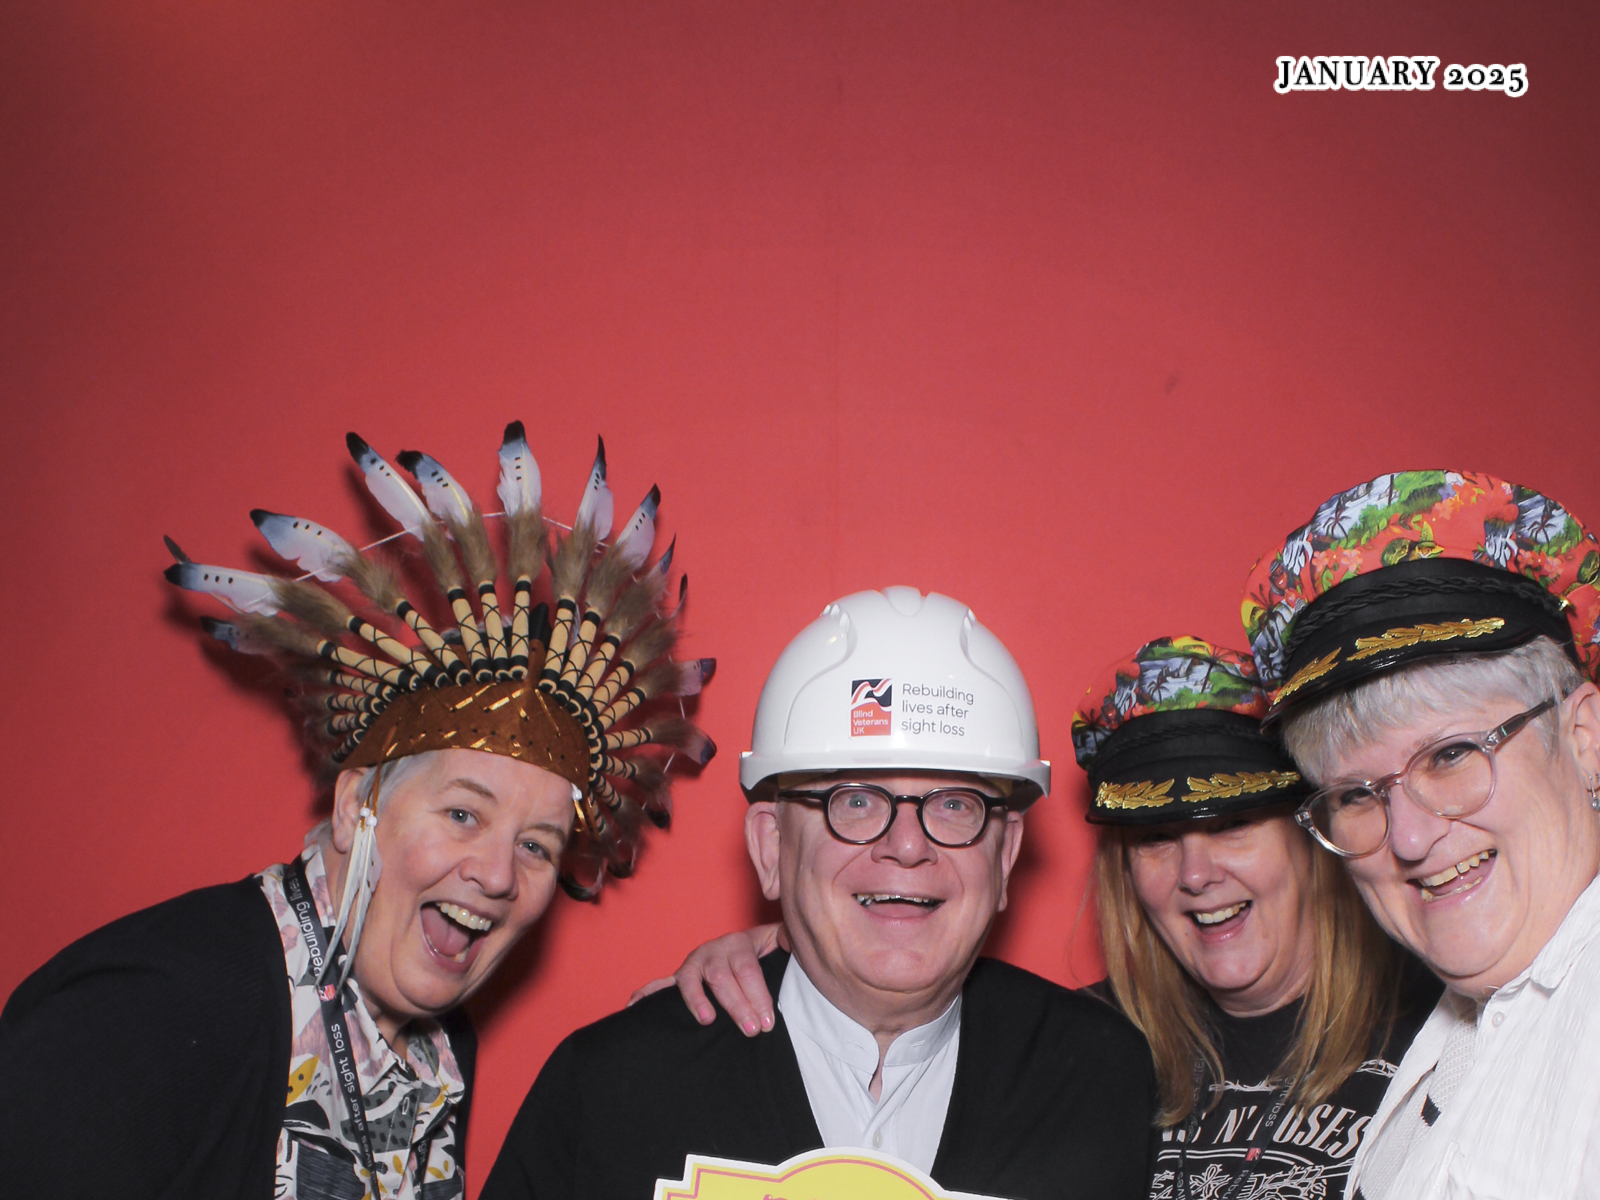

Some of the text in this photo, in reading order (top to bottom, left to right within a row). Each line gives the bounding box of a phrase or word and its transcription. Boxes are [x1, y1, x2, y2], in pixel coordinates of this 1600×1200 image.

[902, 683, 974, 705] Rebuilding
[853, 709, 874, 718] Blind
[902, 700, 969, 718] lives after
[852, 718, 889, 727] Veterans
[853, 727, 865, 735] UK
[901, 718, 965, 736] sight loss
[331, 1023, 345, 1054] loss
[338, 1056, 355, 1094] sight
[1246, 1103, 1374, 1159] OSES
